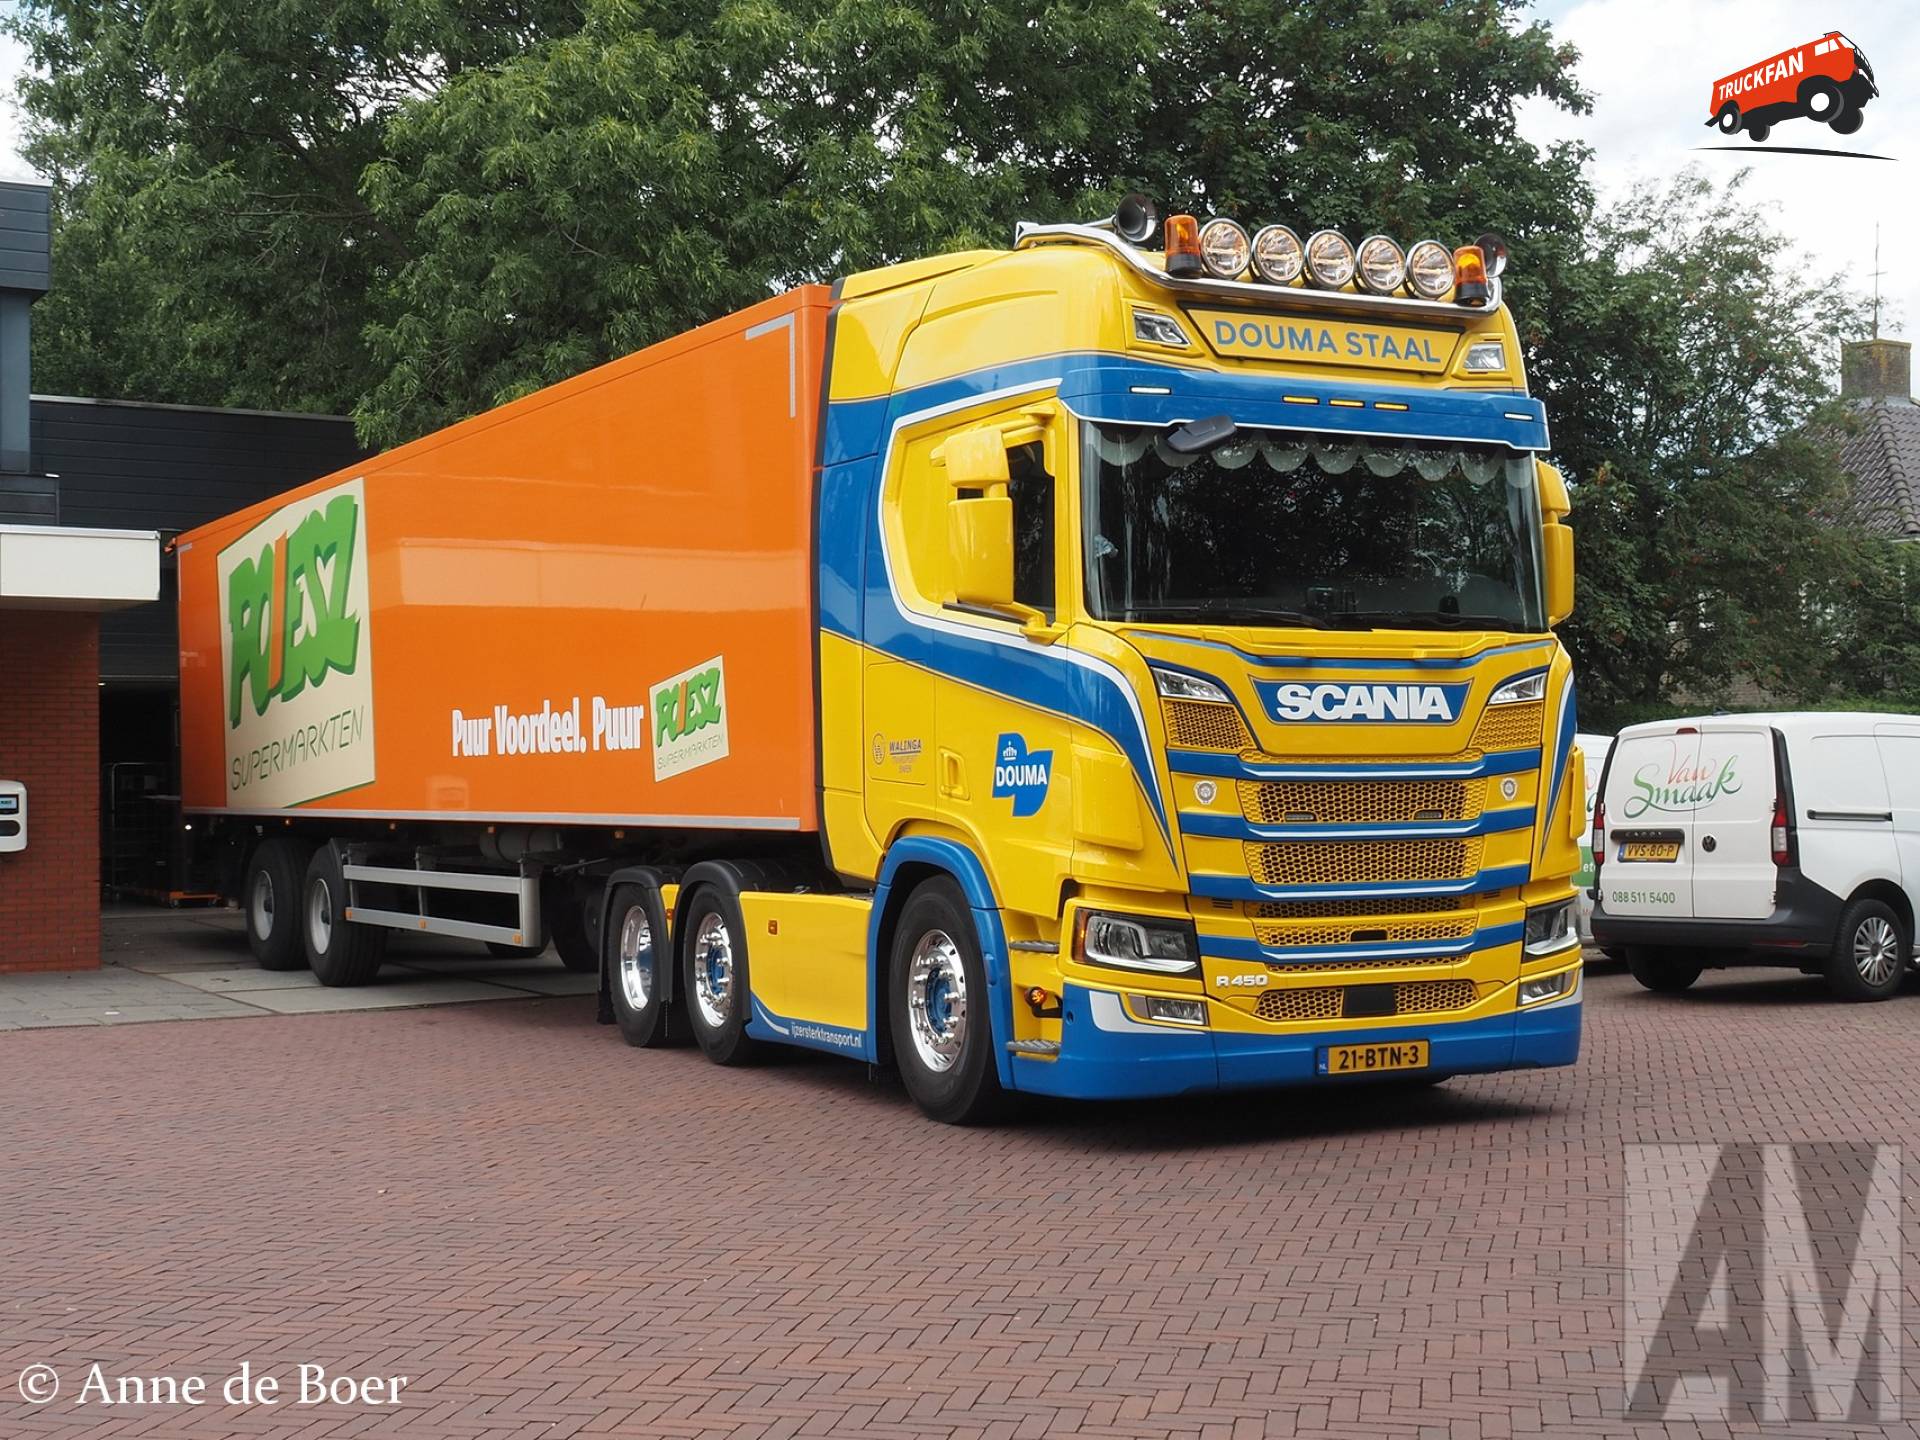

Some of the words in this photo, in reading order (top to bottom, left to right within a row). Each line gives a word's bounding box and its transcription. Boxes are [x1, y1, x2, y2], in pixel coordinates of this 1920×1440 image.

[1214, 320, 1338, 354] DOUMA
[1345, 331, 1441, 363] STAAL
[228, 494, 360, 730] POIESZ
[656, 667, 722, 748] POIESZ
[1276, 683, 1453, 721] SCANIA
[452, 709, 492, 757] Puur
[494, 698, 587, 755] Voordeel.
[592, 696, 645, 751] Puur
[231, 704, 365, 792] SUPERMARKTEN
[656, 734, 724, 770] SUPERMARKTEN
[995, 764, 1048, 787] DOUMA
[1623, 754, 1744, 819] Smaak
[1583, 862, 1596, 873] et
[1612, 891, 1629, 903] 088
[1630, 891, 1646, 903] 511
[1649, 891, 1676, 904] 5400
[1216, 975, 1230, 987] R
[1231, 974, 1268, 987] 450
[1338, 1045, 1420, 1070] 21-BTN-3
